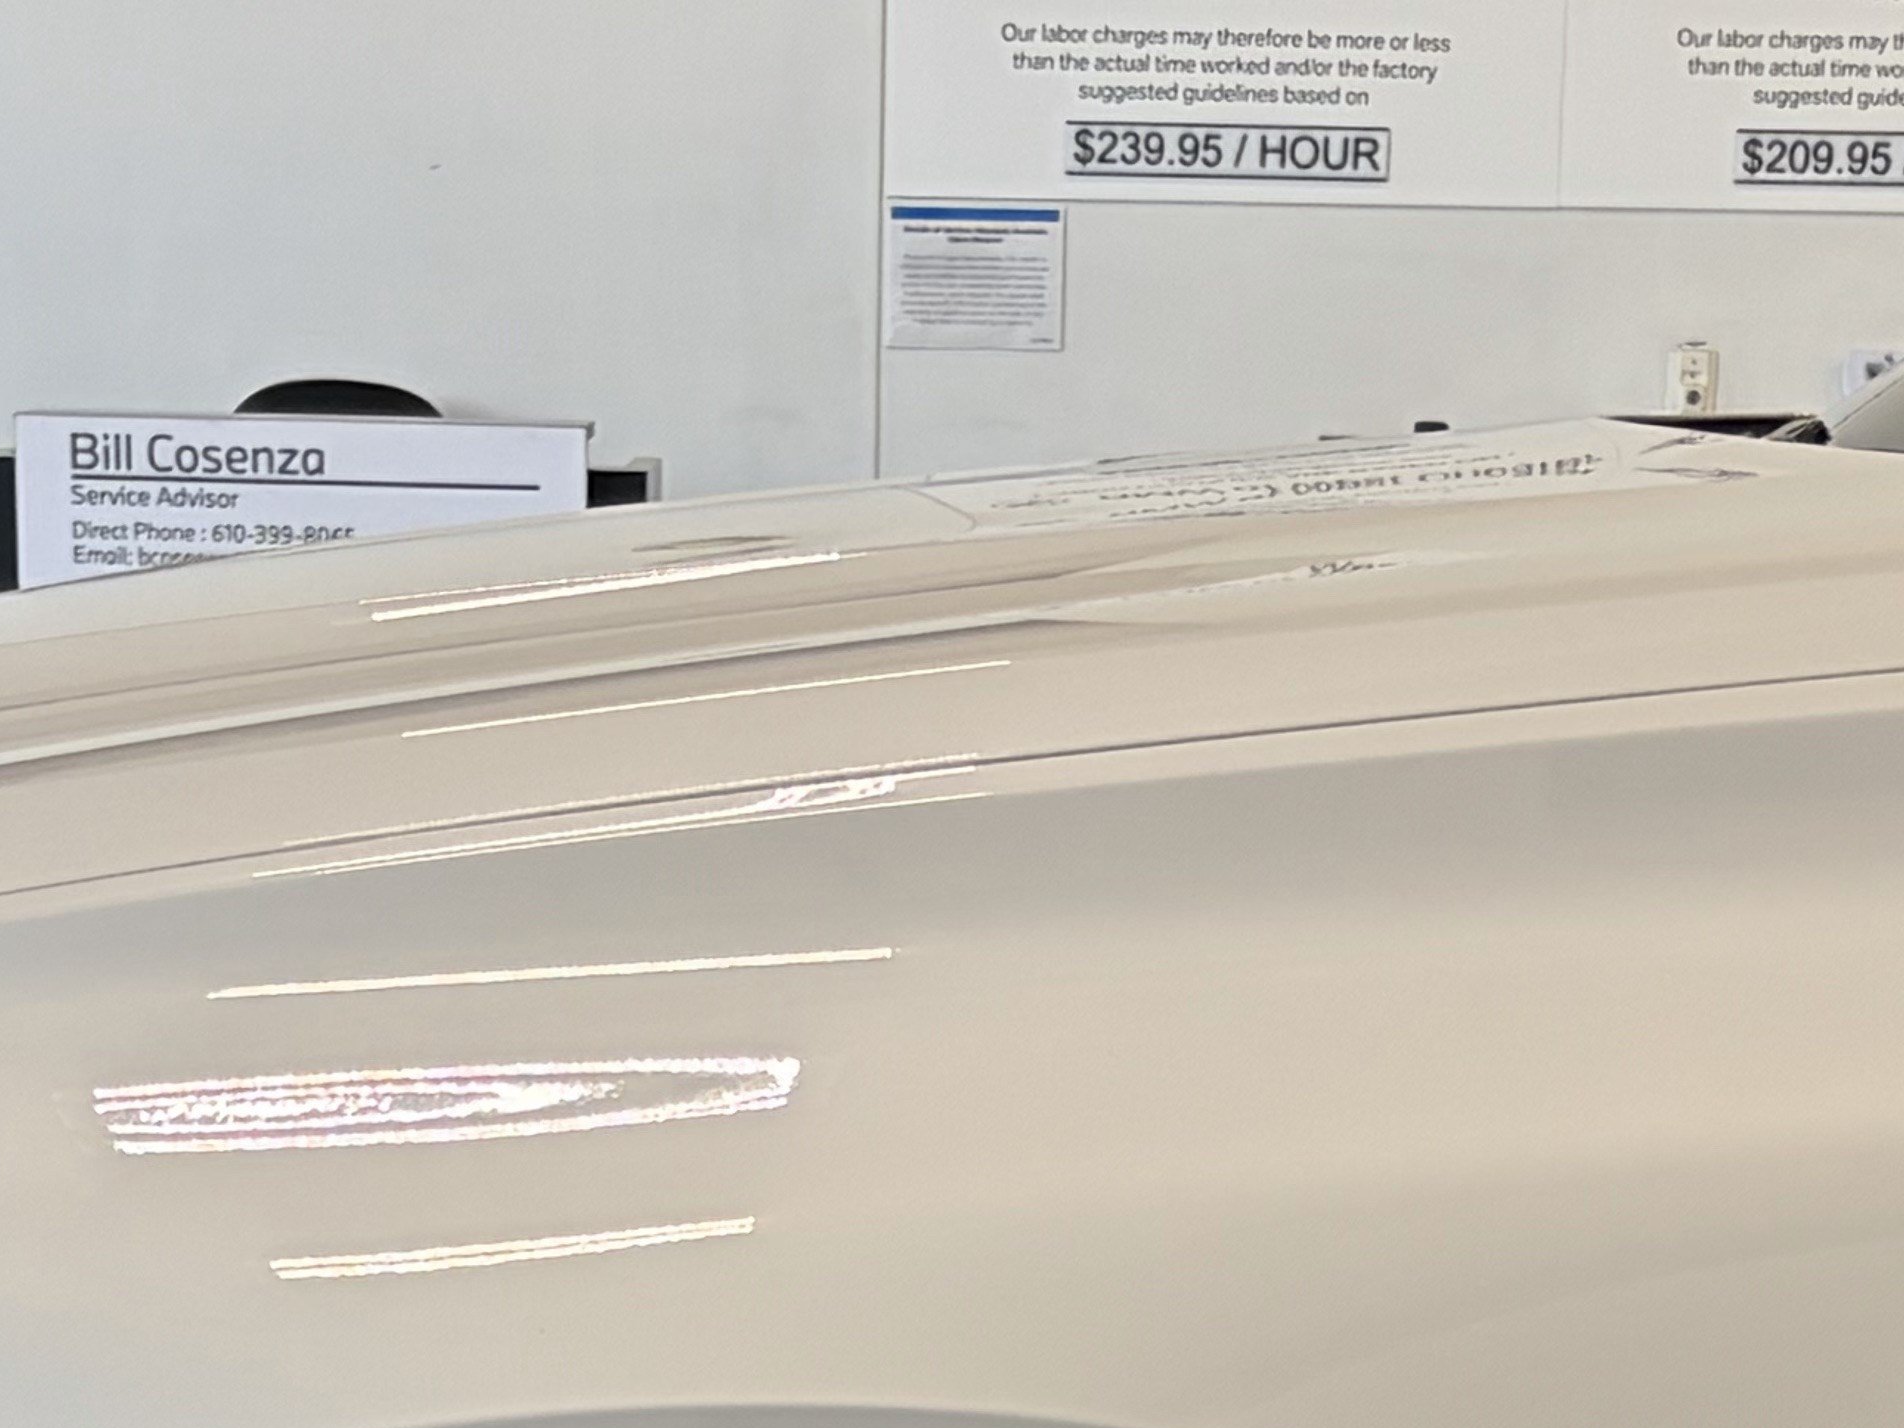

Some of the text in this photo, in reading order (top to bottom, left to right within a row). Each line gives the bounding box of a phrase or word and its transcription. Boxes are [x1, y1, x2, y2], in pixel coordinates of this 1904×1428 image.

[1000, 24, 1451, 52] Our labor charges may therefore be more or less
[1676, 29, 1711, 48] Our
[1717, 29, 1764, 49] labor
[1768, 31, 1843, 53] charges
[1848, 33, 1889, 55] may
[1012, 54, 1438, 84] than the actual time worked and/or the factory
[1687, 58, 1730, 77] than
[1734, 59, 1764, 77] the
[1769, 60, 1826, 79] actual
[1831, 61, 1871, 79] time
[1078, 82, 1369, 107] suggested guidelines based on
[1753, 87, 1853, 108] suggested
[1072, 128, 1381, 171] $239.95 / HOUR
[1741, 138, 1894, 176] $209.95
[70, 432, 326, 476] Bill Cosenza
[70, 485, 239, 508] Service Advisor
[72, 520, 128, 540] Direct
[134, 522, 196, 542] Phone
[72, 545, 132, 566] Email:
